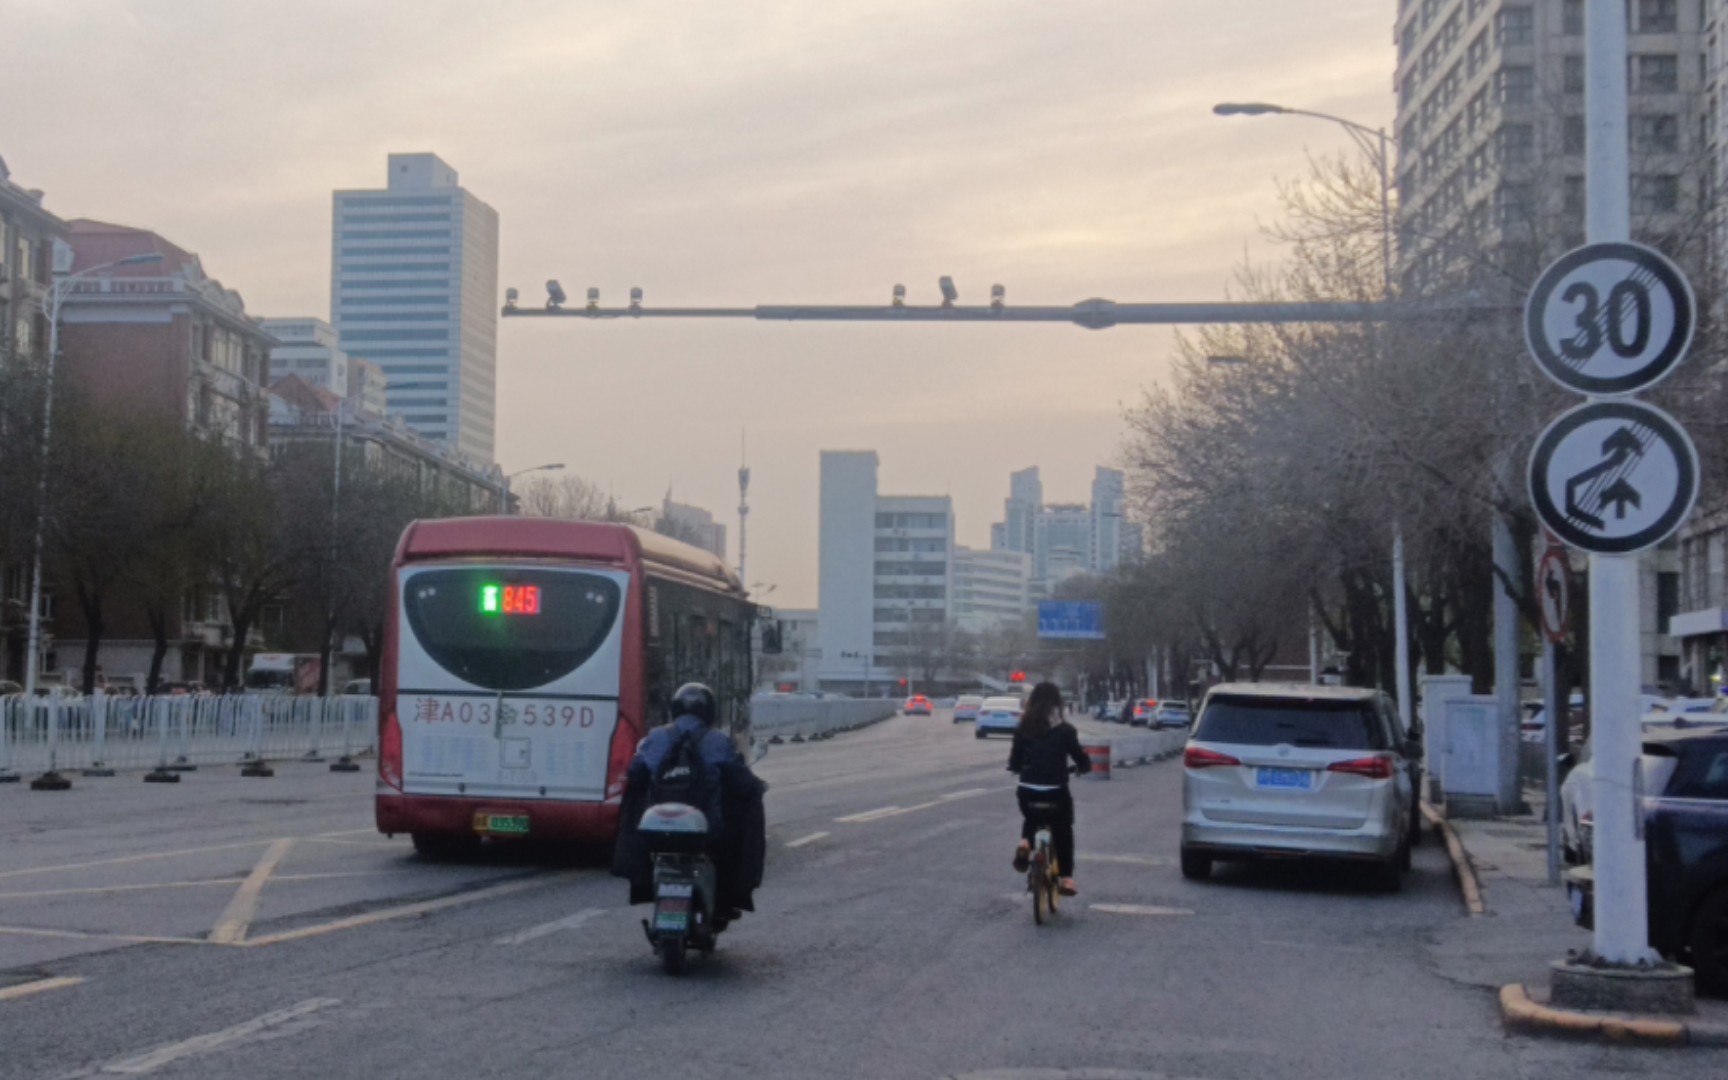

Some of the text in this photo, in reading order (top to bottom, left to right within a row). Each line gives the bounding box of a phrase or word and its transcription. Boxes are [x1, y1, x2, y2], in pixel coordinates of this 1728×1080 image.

[1560, 280, 1650, 359] 30
[503, 586, 538, 611] 845
[523, 704, 594, 728] 539D
